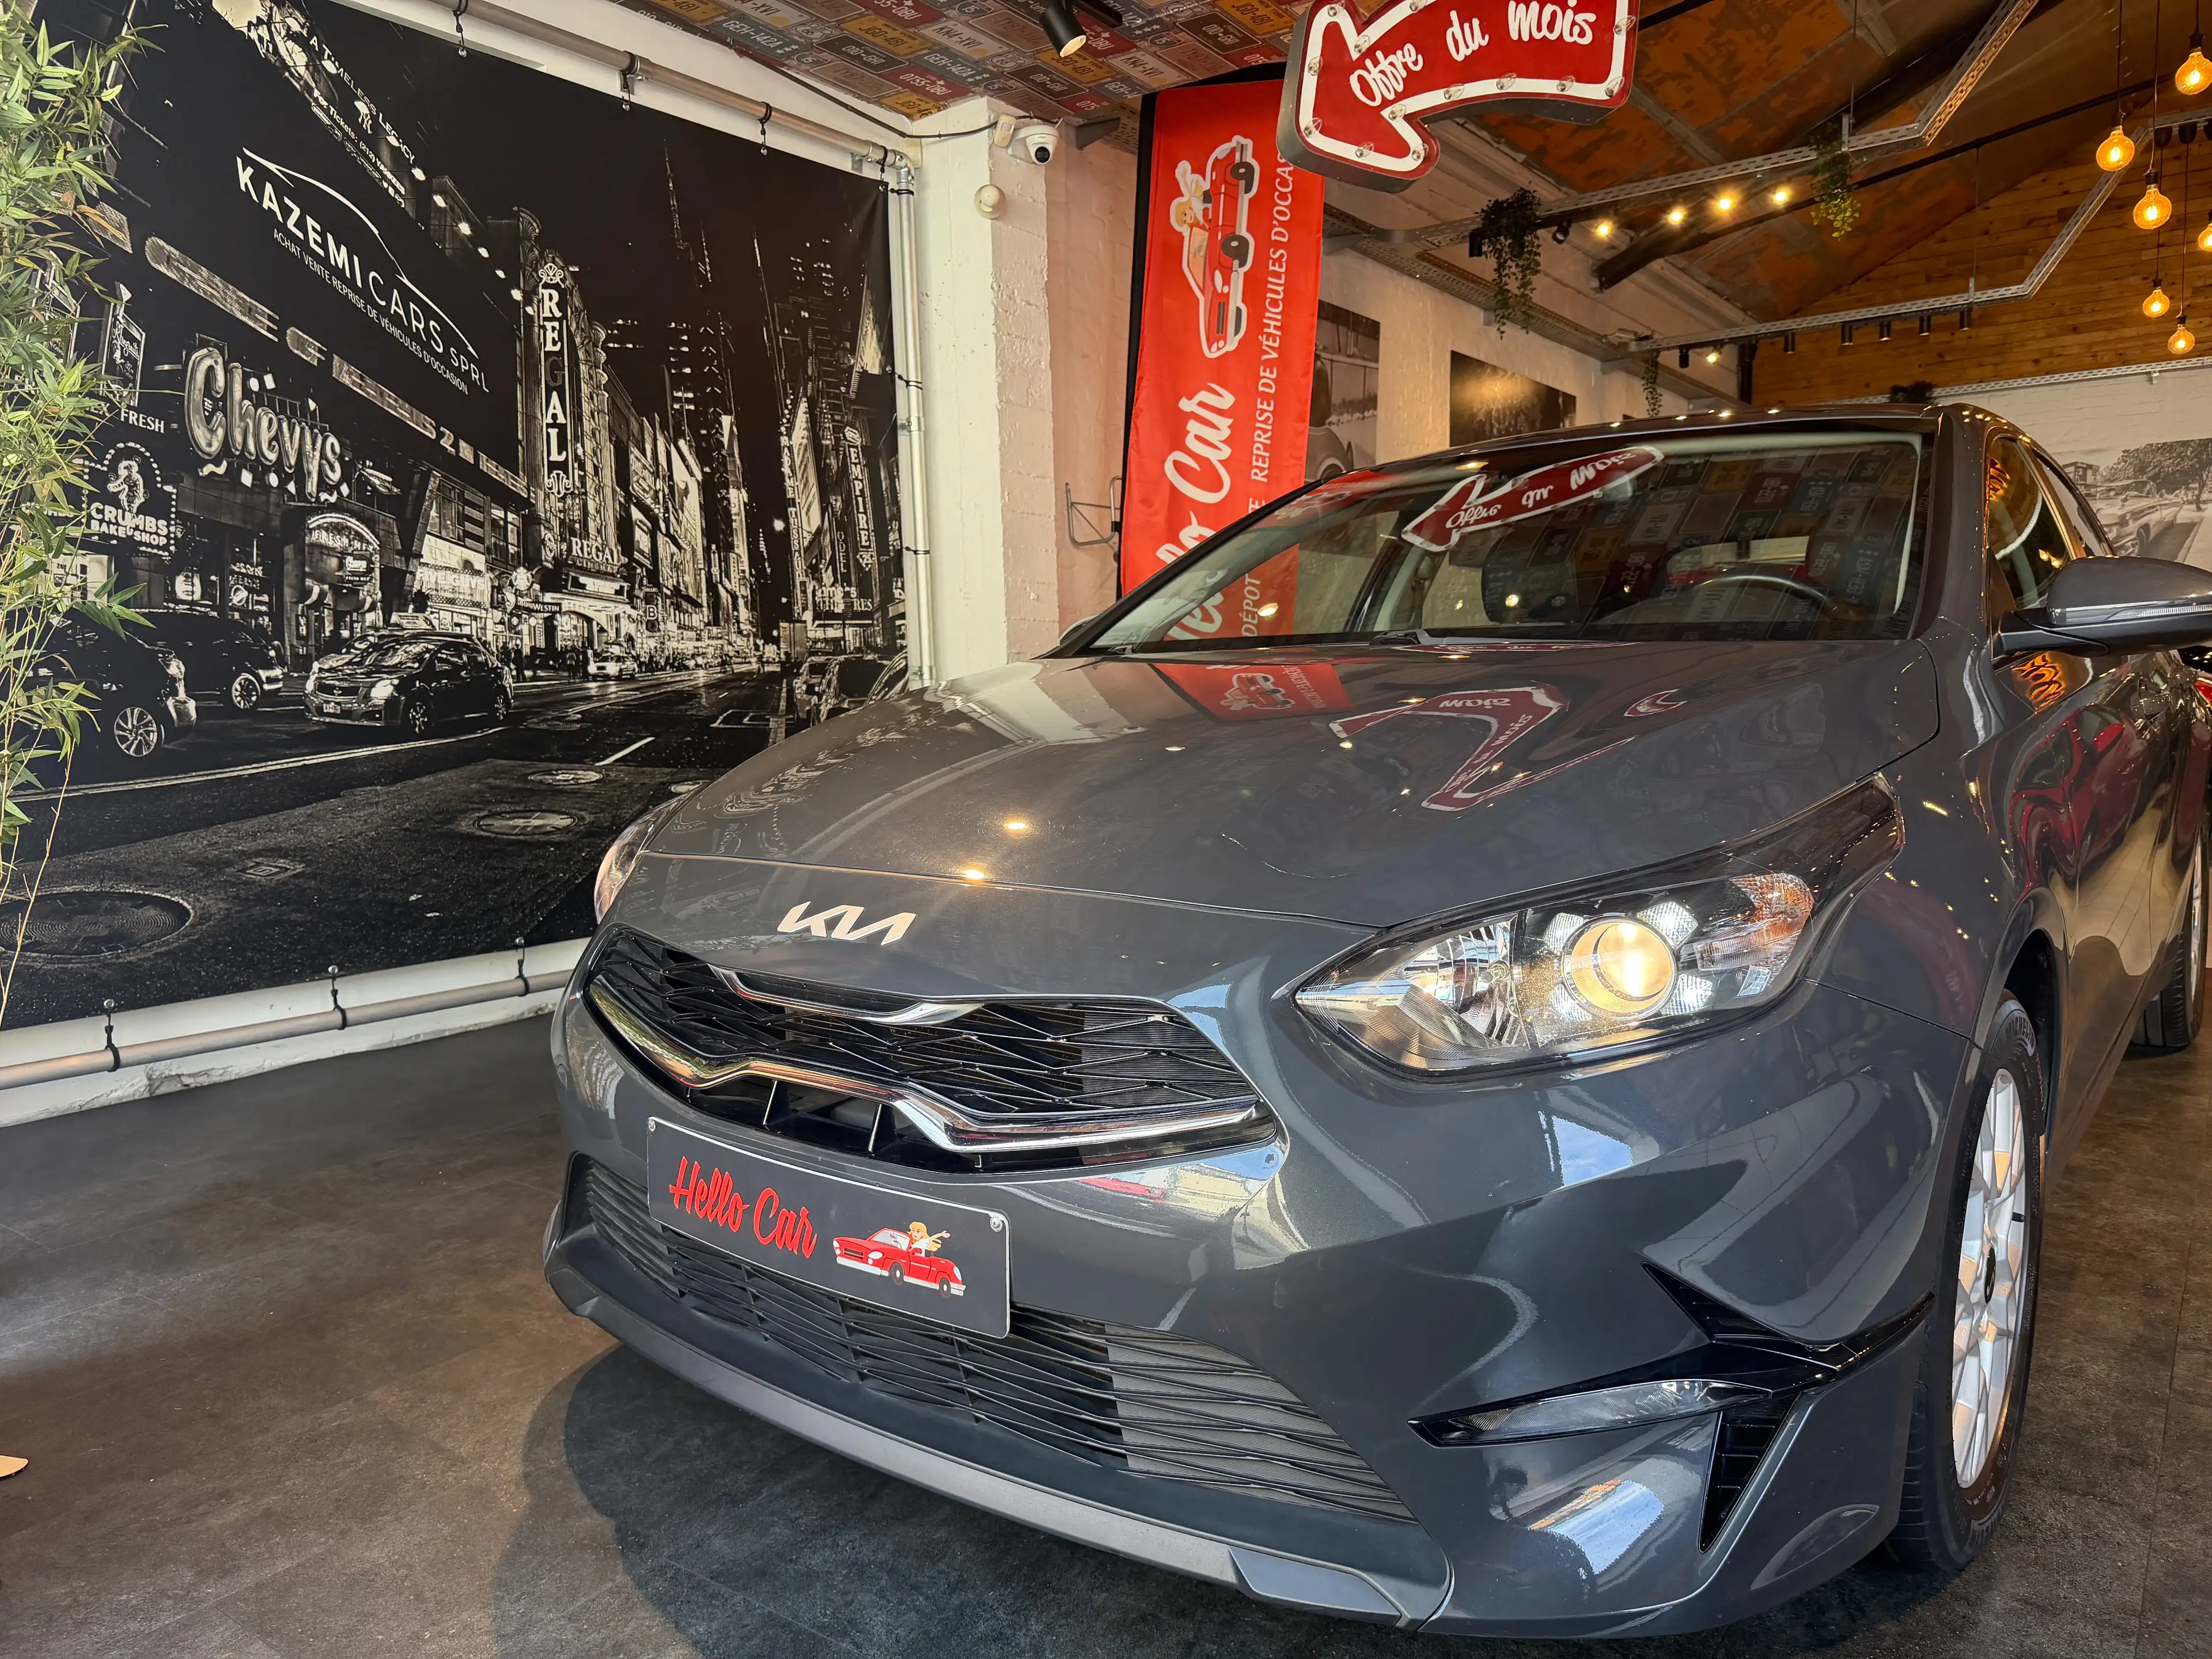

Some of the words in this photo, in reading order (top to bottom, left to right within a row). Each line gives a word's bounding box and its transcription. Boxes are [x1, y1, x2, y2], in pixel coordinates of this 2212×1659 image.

[309, 35, 319, 52] A
[722, 20, 783, 49] GEH-142A
[923, 52, 976, 78] GEH-142A
[1349, 42, 1423, 108] Offre
[1446, 10, 1489, 62] du
[236, 156, 362, 288] KAZEMI
[369, 271, 444, 354] CARS
[450, 346, 490, 393] SPRL
[1258, 248, 1288, 361] VÉHICULES
[273, 228, 302, 259] ACHAT
[302, 251, 331, 284] VENTE
[332, 275, 367, 313] REPRISE
[367, 304, 379, 323] DE
[379, 315, 422, 358] VÉHICULES
[423, 348, 468, 395] D'OCCASION
[541, 288, 567, 463] REGAL
[1258, 366, 1277, 394] DE
[120, 408, 165, 433] FRESH
[185, 347, 342, 502] Chevys
[1164, 382, 1236, 504] Car
[1251, 397, 1274, 483] REPRISE
[90, 502, 168, 536] CRUMBS
[849, 447, 870, 547] EMPIRE
[90, 519, 127, 539] BAKE
[133, 530, 168, 547] SHOP
[570, 536, 622, 566] REGAL
[533, 603, 560, 612] WESTIN
[777, 901, 917, 946] KIA
[668, 1156, 751, 1233] Hello
[753, 1187, 818, 1259] Car
